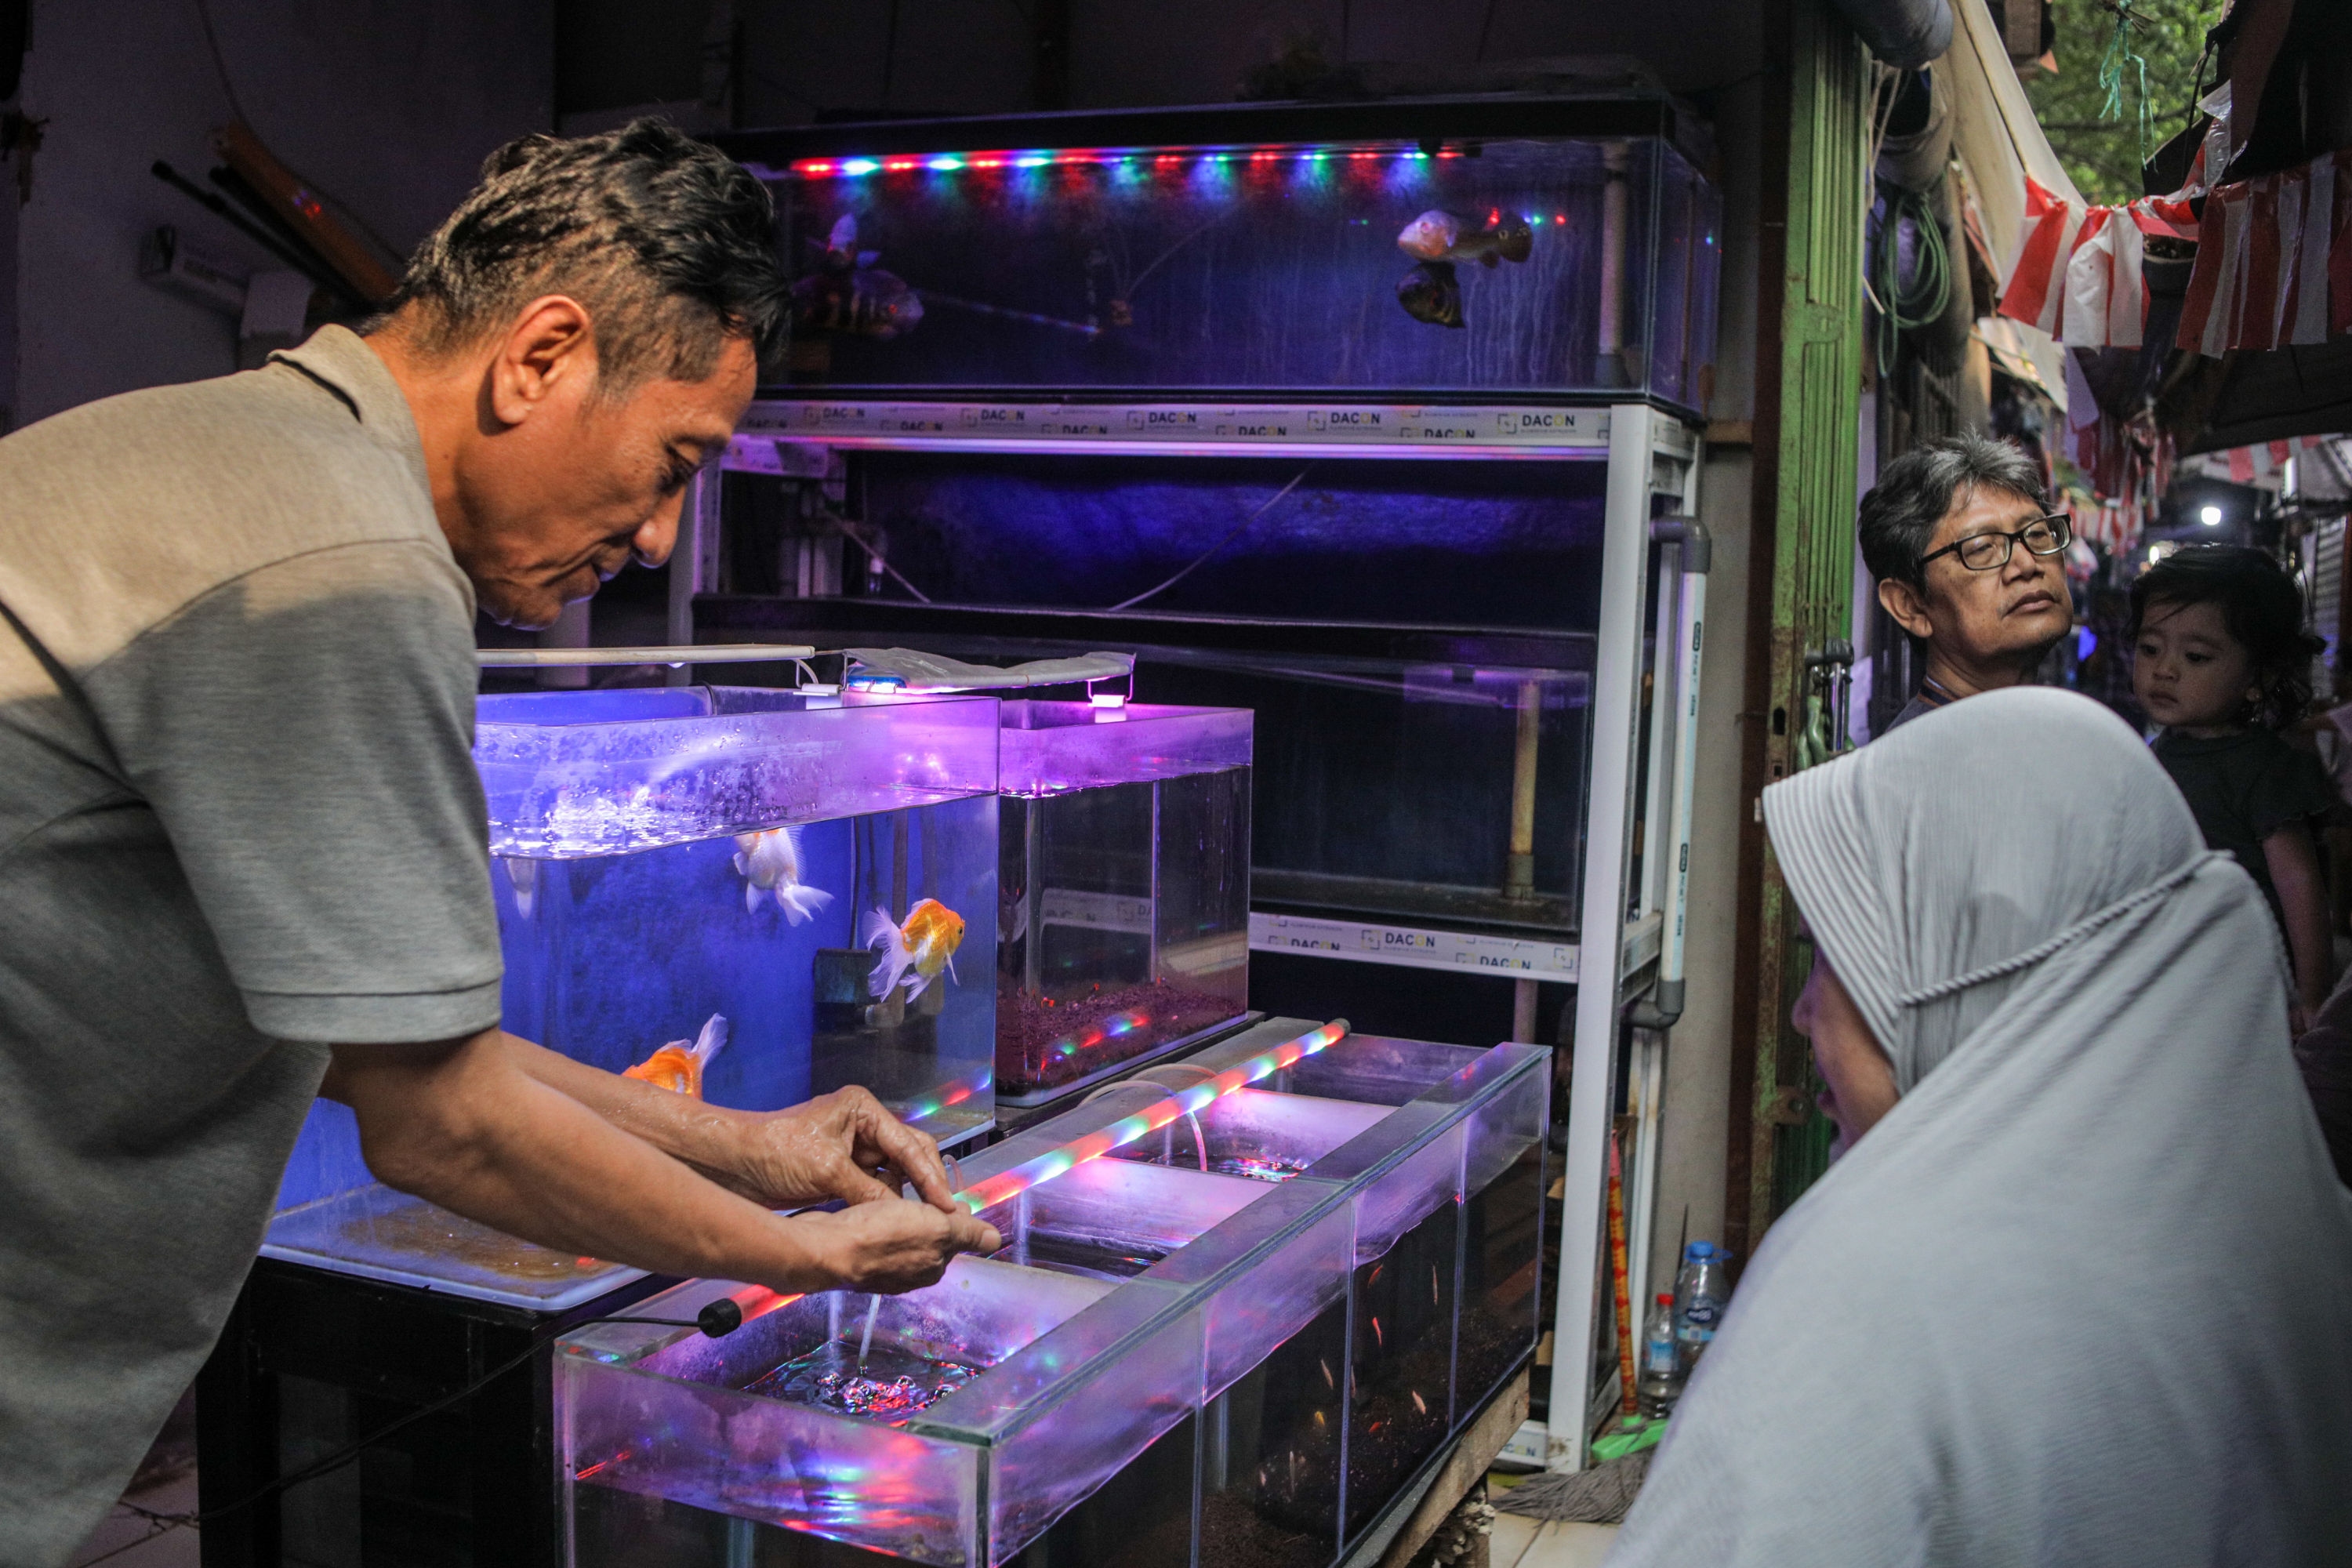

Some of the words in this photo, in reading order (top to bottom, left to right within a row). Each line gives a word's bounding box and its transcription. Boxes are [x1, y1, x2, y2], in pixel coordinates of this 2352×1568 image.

[982, 409, 1025, 421] DACON
[1149, 412, 1196, 423] DACON
[1330, 412, 1381, 424] DACON
[1523, 415, 1575, 426] DACON
[1062, 425, 1107, 434] DACON
[1239, 426, 1287, 436] DACON
[1425, 428, 1475, 438] DACON
[1291, 938, 1340, 951] DACON
[1385, 932, 1435, 947] DACON
[1480, 956, 1531, 970] DACON
